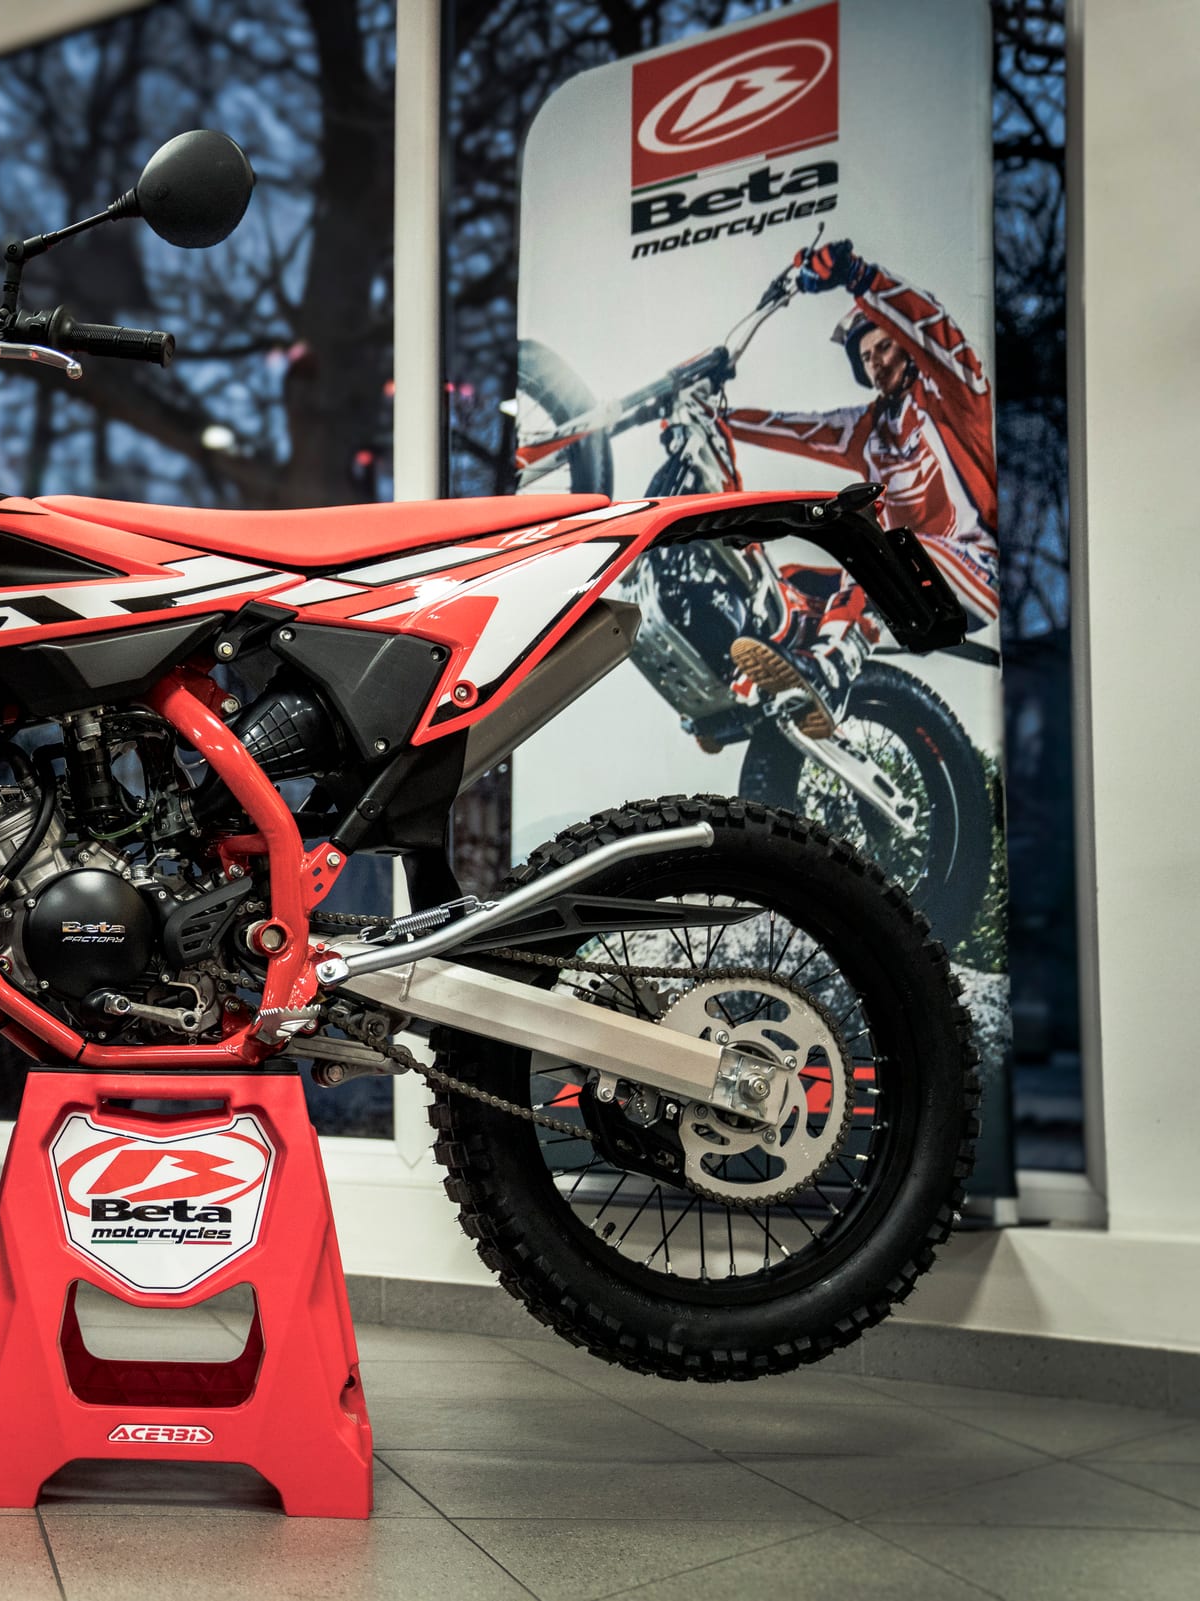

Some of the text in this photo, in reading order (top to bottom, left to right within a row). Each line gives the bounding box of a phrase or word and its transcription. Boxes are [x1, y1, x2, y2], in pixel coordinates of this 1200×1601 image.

[631, 160, 839, 236] Beta
[631, 194, 838, 260] motorcycles
[62, 921, 126, 934] Beta
[62, 935, 125, 943] FACTORY
[91, 1198, 232, 1223] Beta
[91, 1226, 232, 1244] motorcycles
